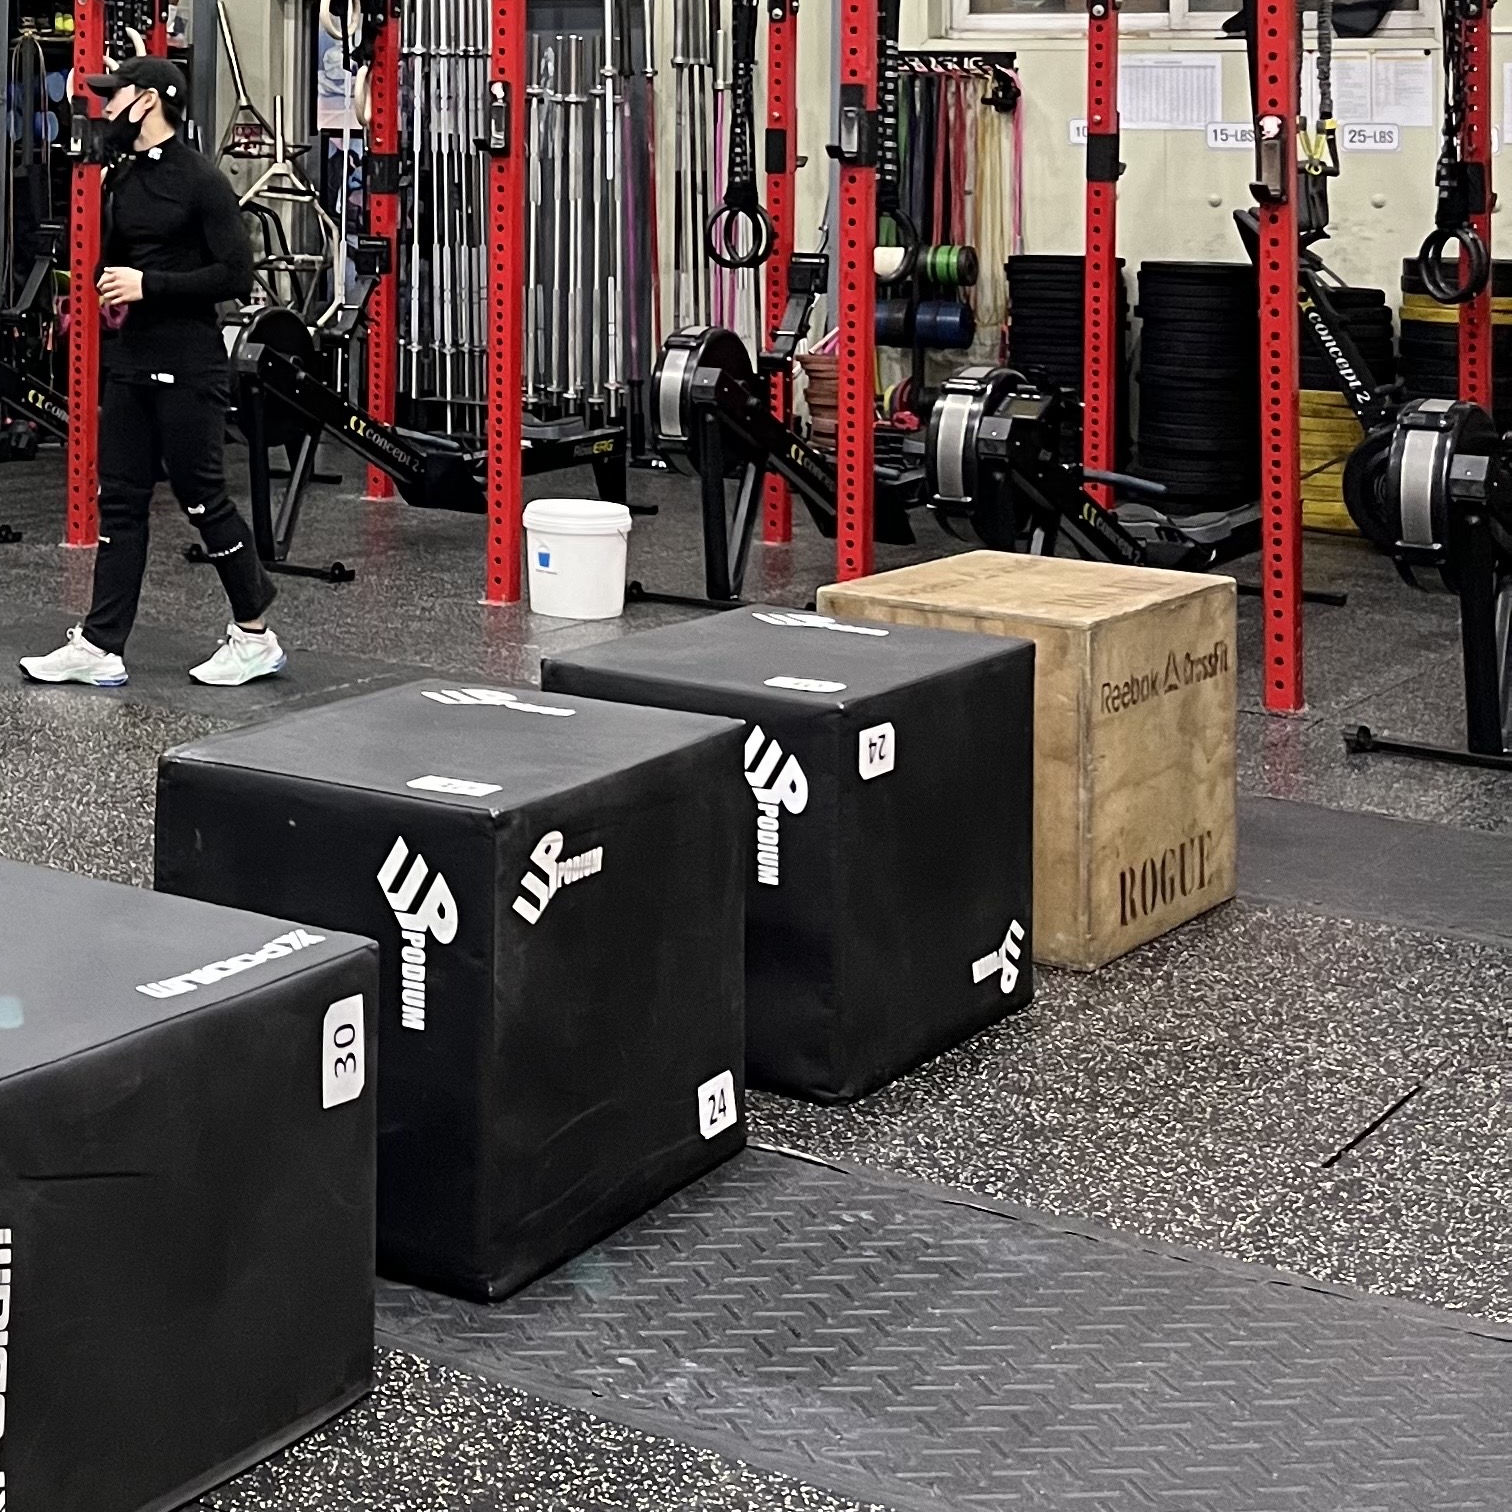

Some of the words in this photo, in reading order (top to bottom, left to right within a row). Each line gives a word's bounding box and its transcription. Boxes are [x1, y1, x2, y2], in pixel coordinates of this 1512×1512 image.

[1348, 129, 1394, 144] 25-LBS
[1308, 311, 1362, 390] concept
[1356, 390, 1371, 404] 2
[1100, 668, 1162, 715] Reebok
[868, 733, 888, 765] 24
[1119, 830, 1216, 925] ROGUE
[401, 930, 426, 1031] PODIUM
[333, 1023, 357, 1078] 30
[707, 1088, 728, 1127] 24
